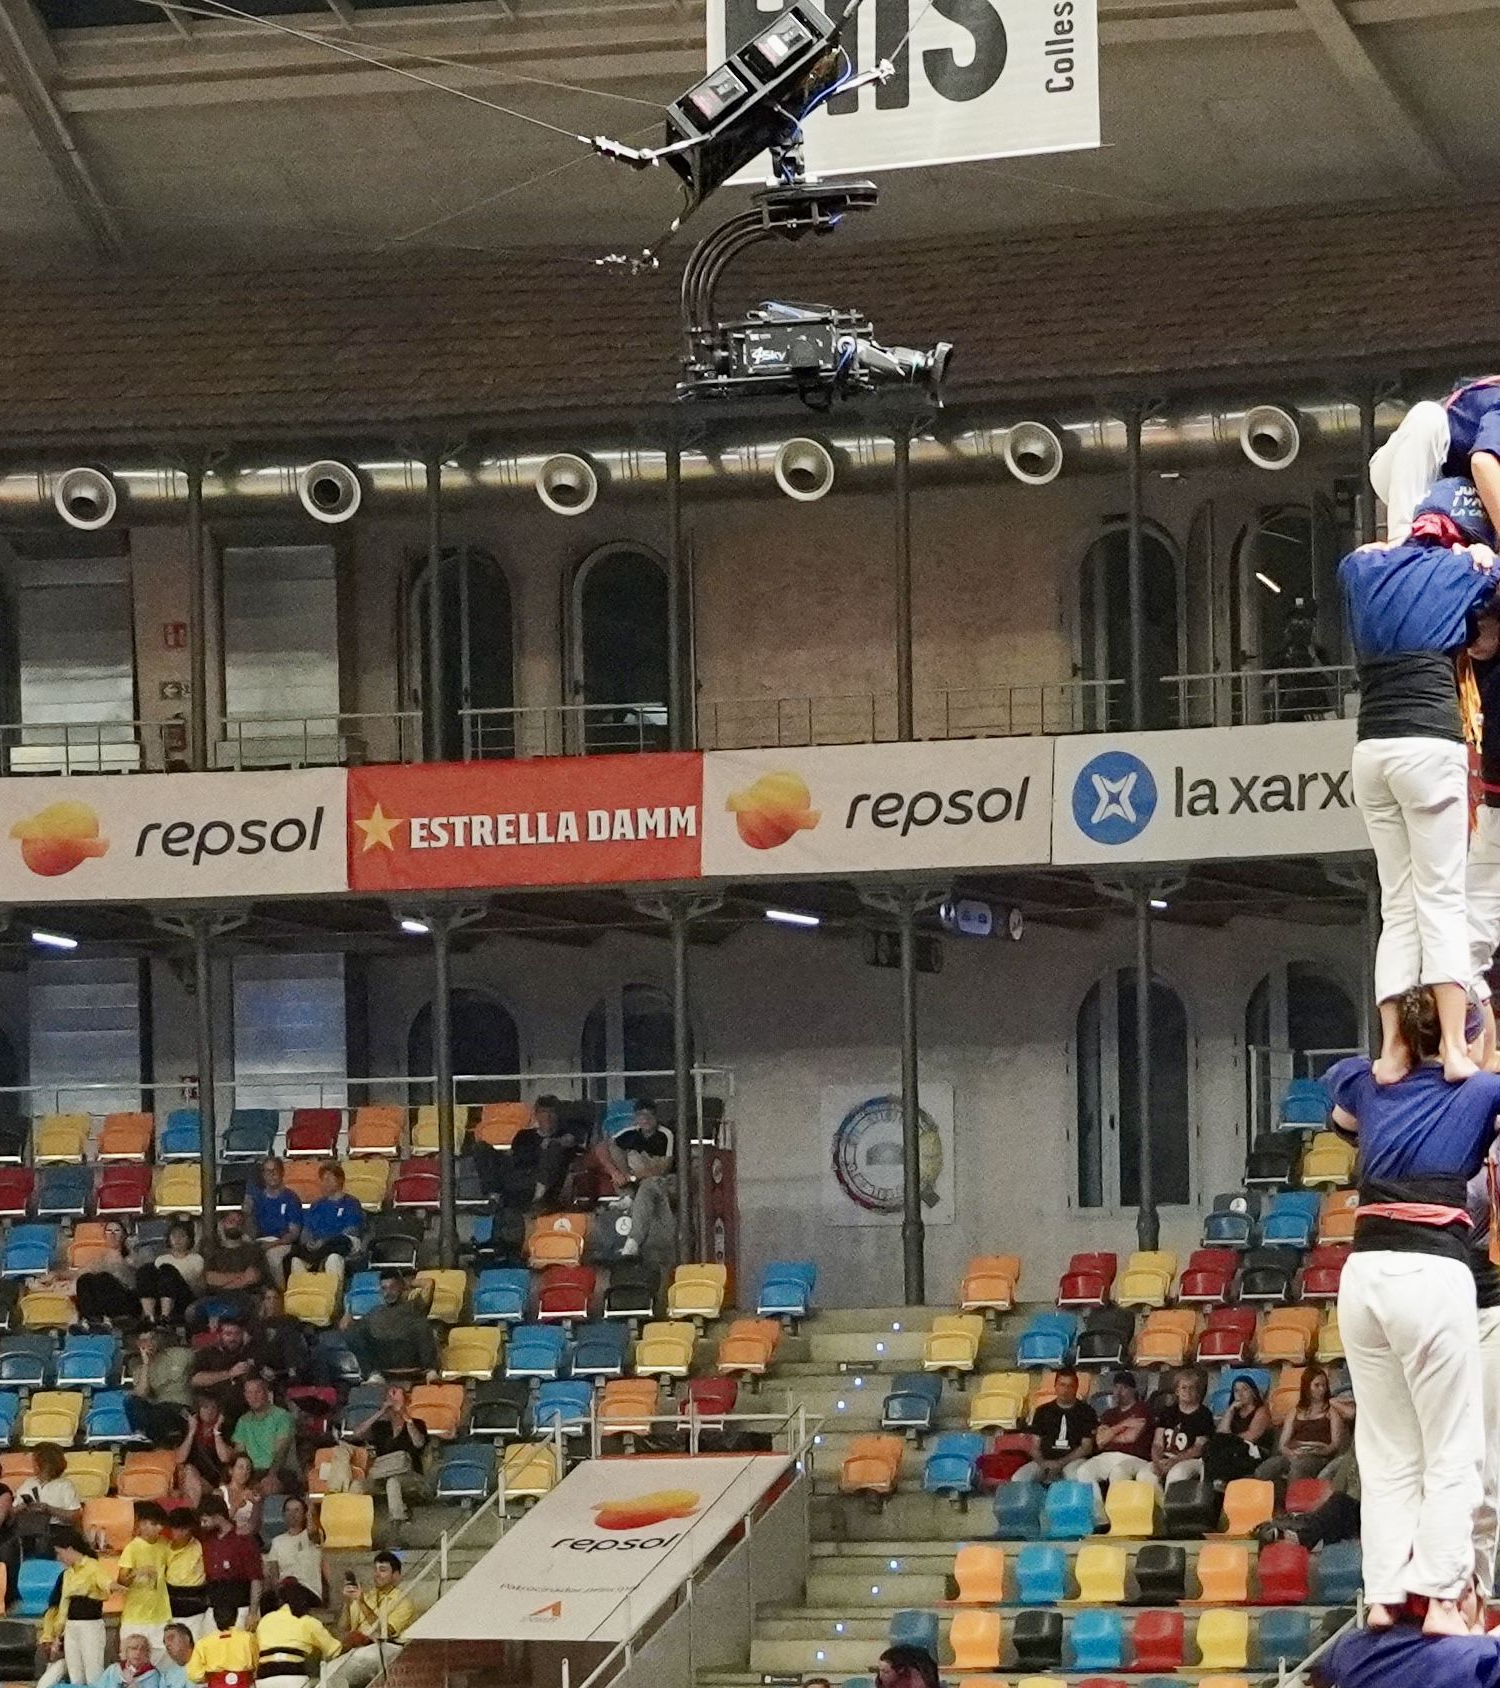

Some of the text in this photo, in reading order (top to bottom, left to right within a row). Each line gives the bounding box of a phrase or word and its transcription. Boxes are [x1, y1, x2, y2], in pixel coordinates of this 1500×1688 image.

[409, 805, 698, 851] ESTRELLA DAMM
[845, 776, 1030, 837] repsol
[135, 806, 324, 866] repsol
[551, 1532, 683, 1554] repsol
